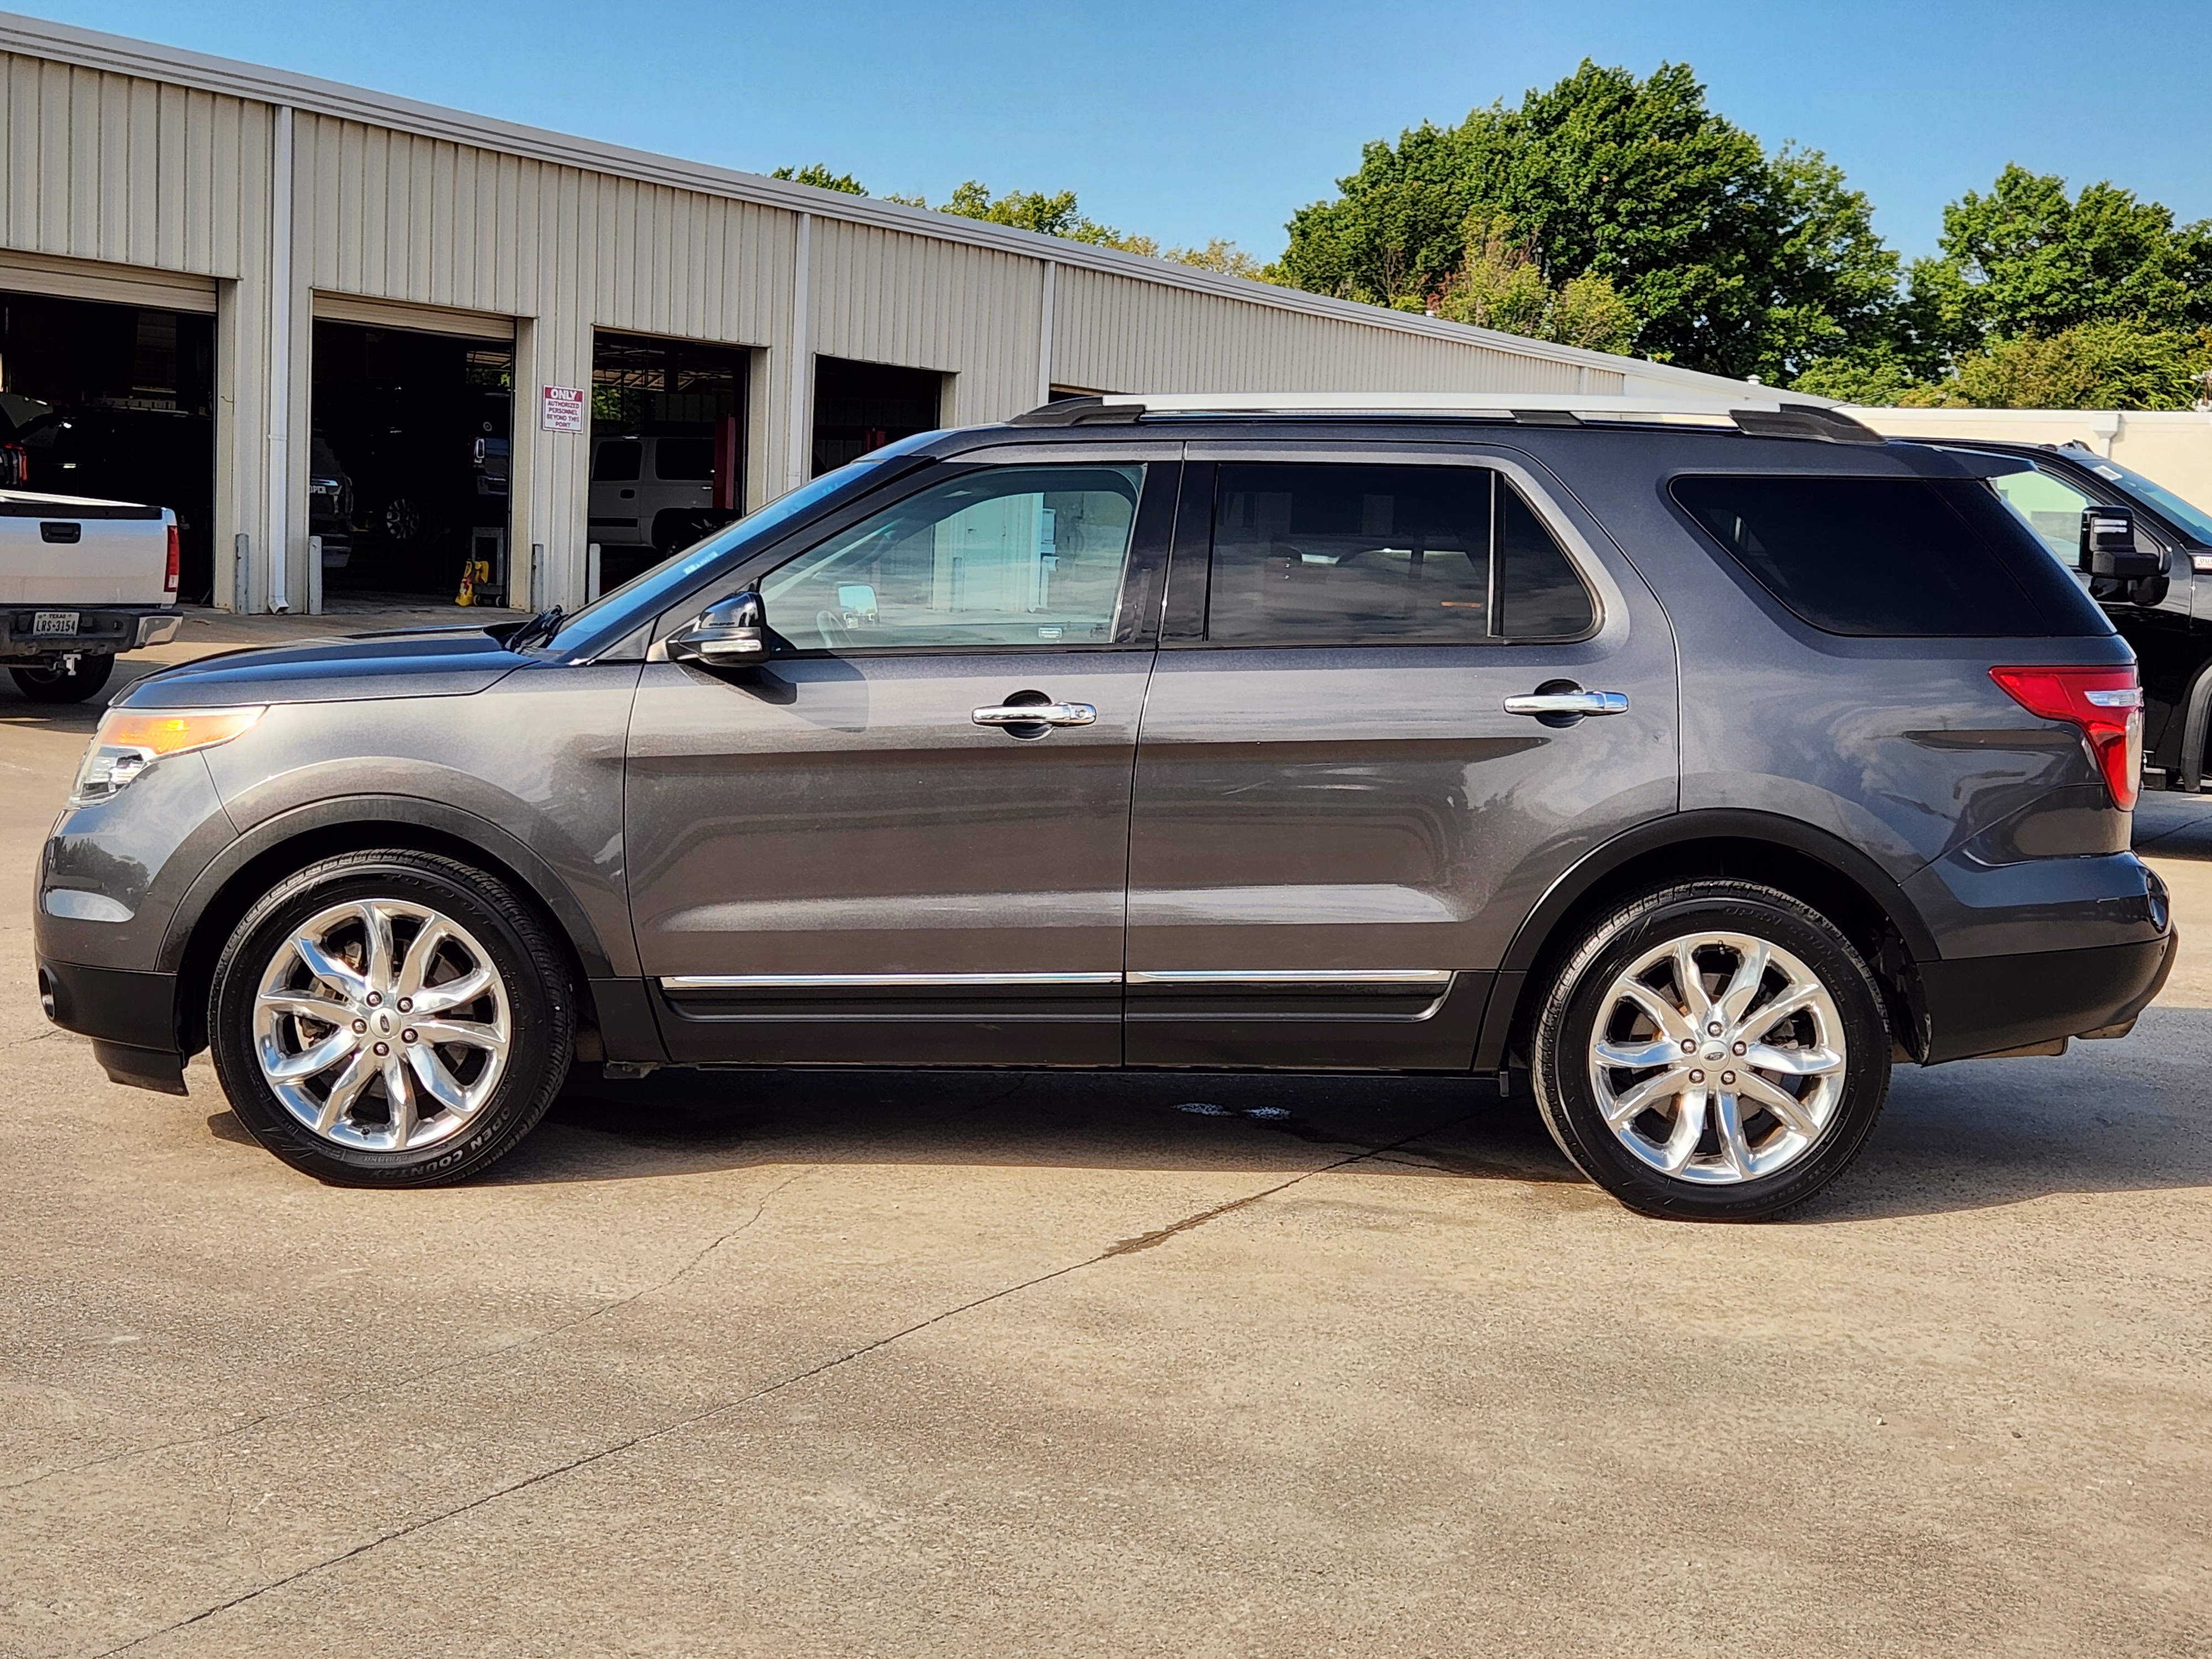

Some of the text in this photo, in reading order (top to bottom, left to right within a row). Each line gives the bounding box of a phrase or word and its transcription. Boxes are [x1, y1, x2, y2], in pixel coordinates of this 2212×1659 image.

[550, 389, 577, 400] ONLY
[547, 400, 580, 409] AUTHORIZED
[548, 407, 578, 415] PERSONNEL
[469, 1105, 512, 1151] OPEN
[368, 1148, 465, 1179] COUNTRY
